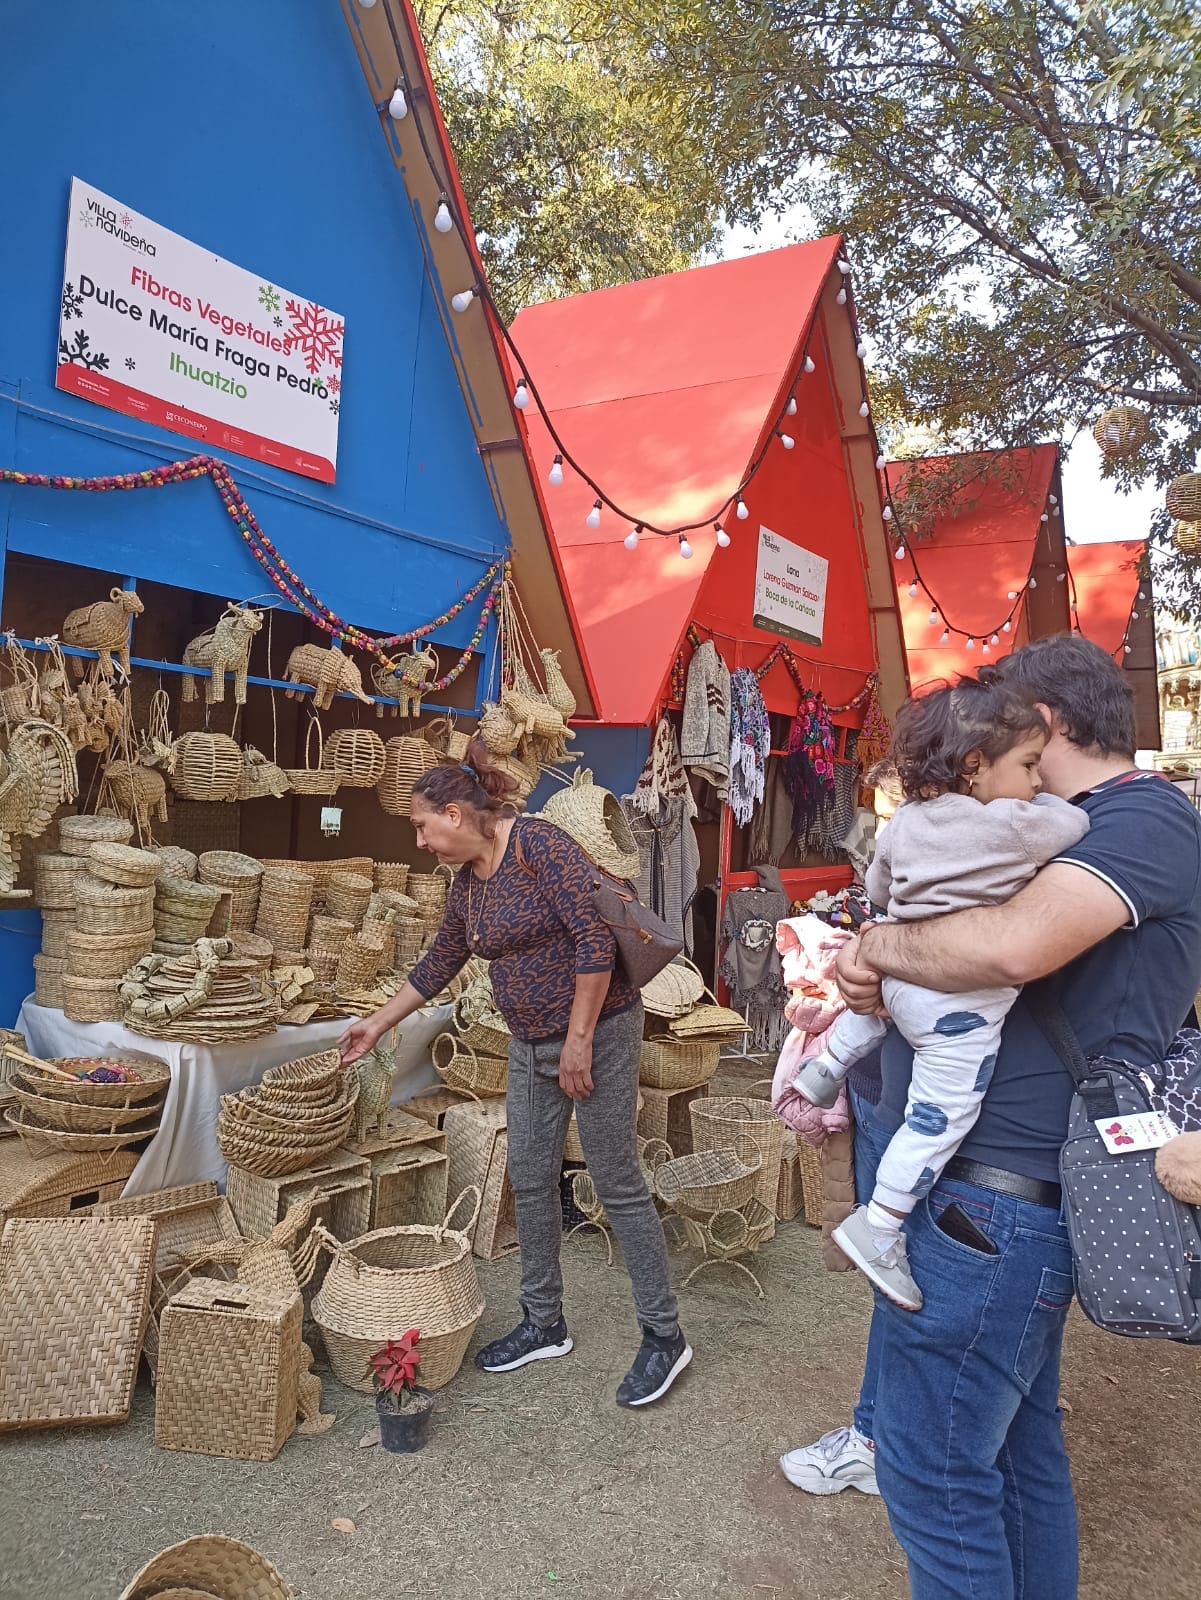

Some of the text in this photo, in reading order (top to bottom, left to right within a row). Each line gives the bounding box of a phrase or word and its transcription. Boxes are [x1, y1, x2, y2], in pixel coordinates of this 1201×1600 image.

[131, 265, 291, 356] Fibras Vegetales
[79, 274, 329, 400] Dulce María Fraga Pedro
[169, 351, 248, 399] Ihuatzio
[787, 564, 800, 577] Lana
[765, 588, 779, 602] Boca
[780, 595, 788, 606] de
